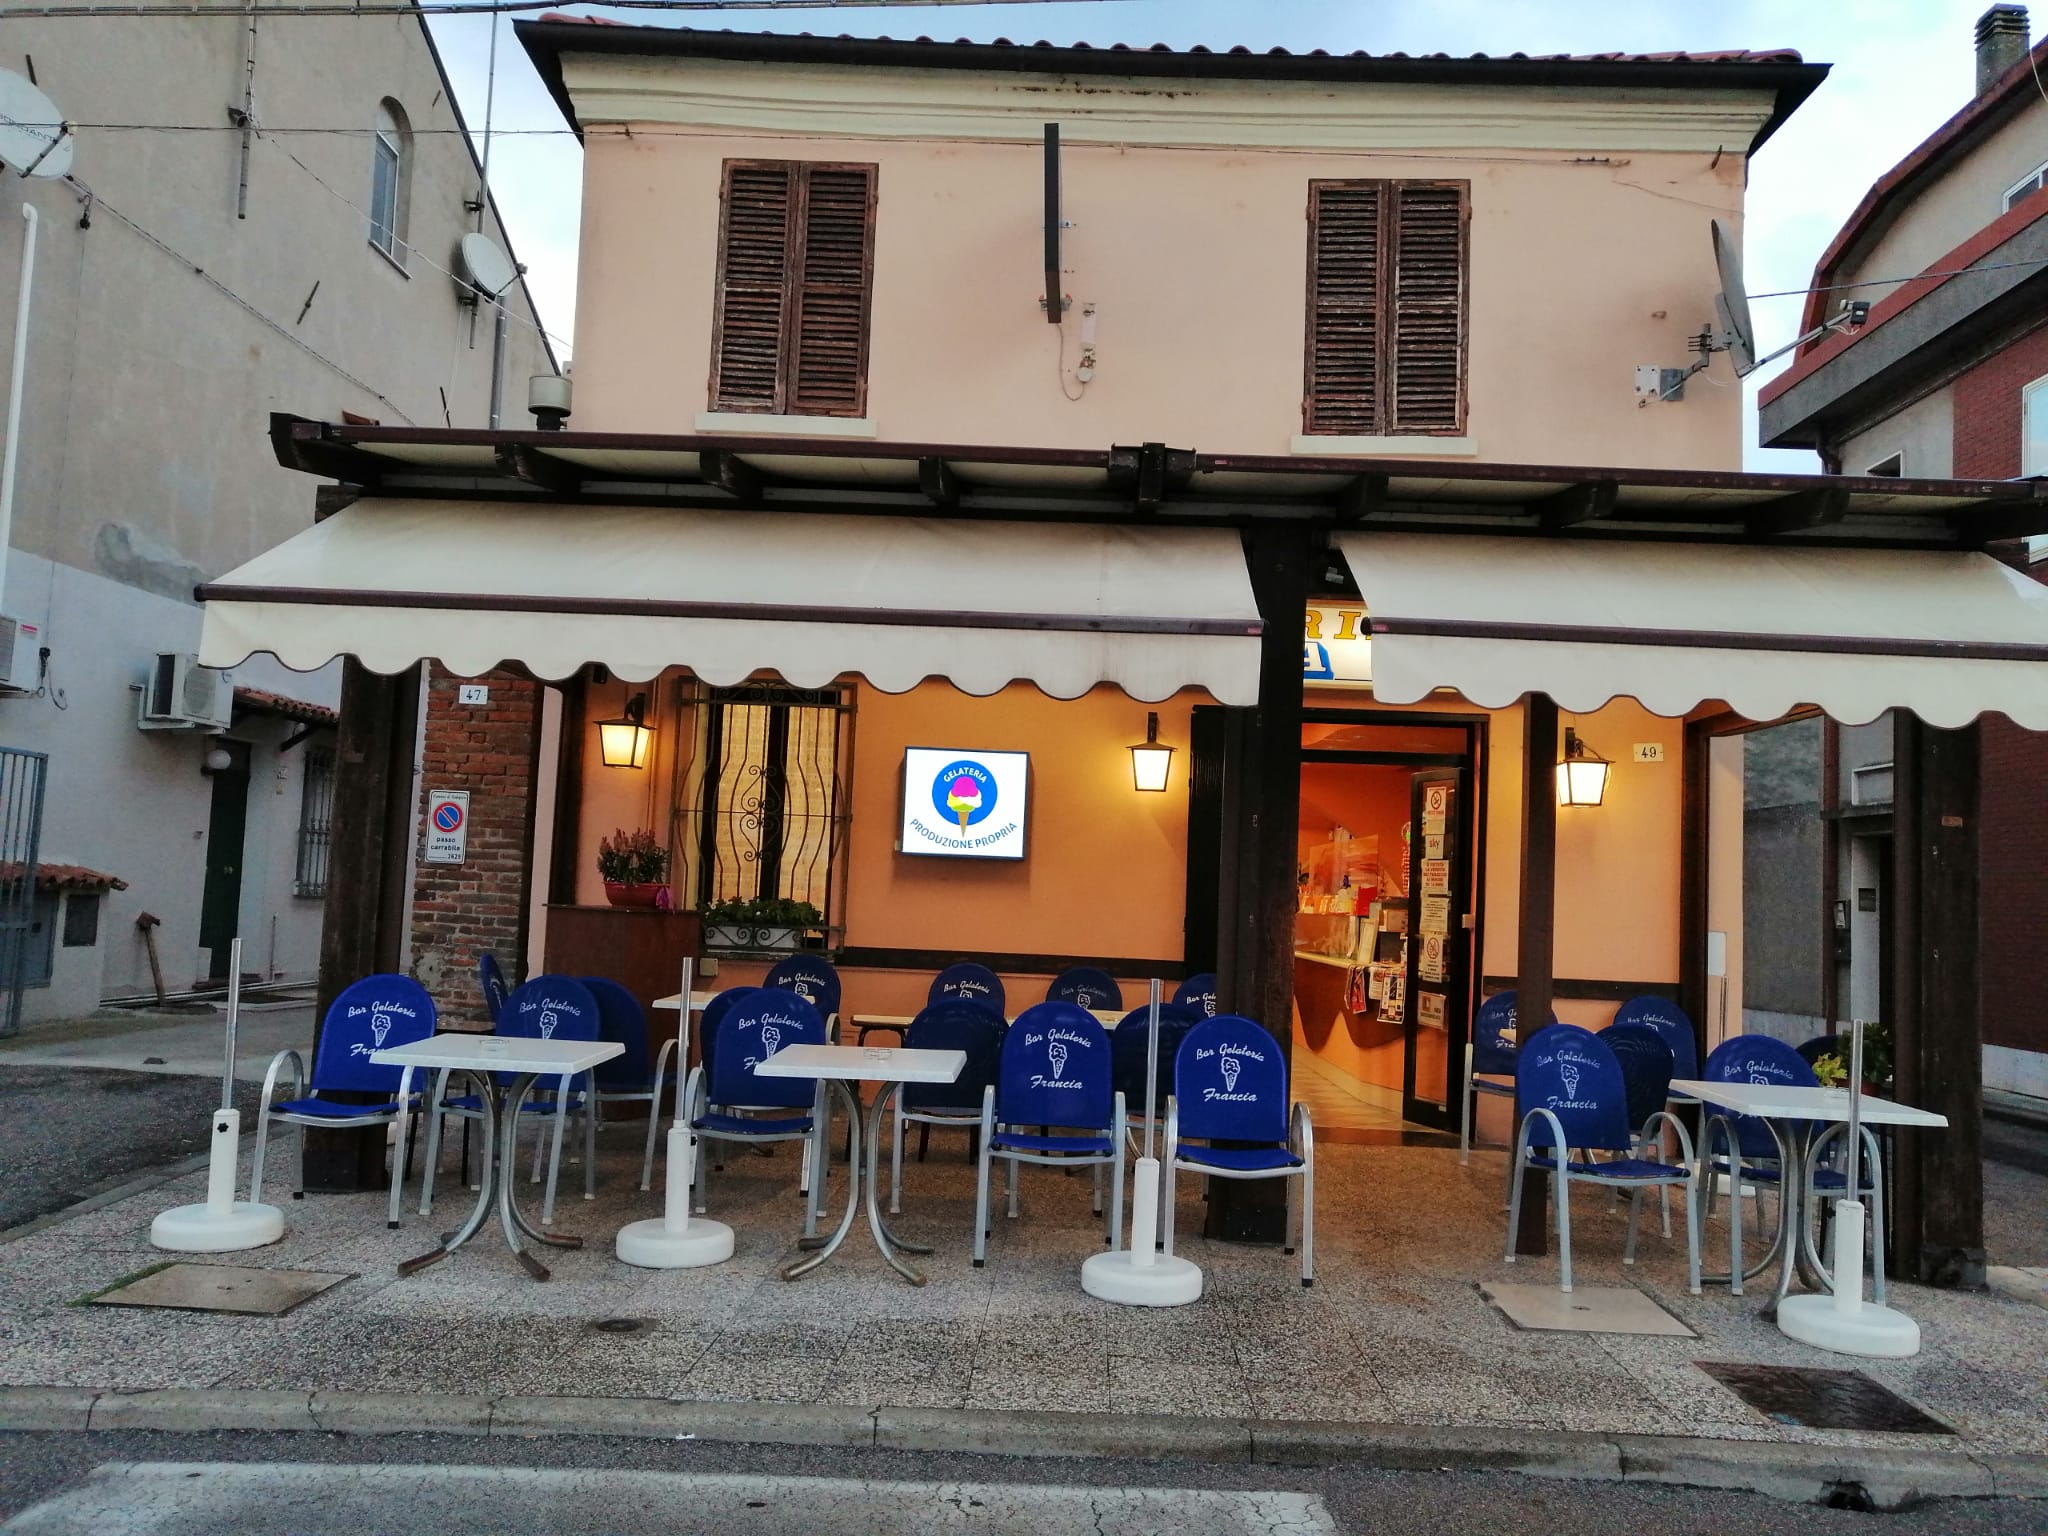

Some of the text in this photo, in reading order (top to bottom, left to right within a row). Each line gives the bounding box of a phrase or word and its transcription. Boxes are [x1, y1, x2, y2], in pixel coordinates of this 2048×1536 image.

[466, 689, 481, 701] 47
[1641, 746, 1657, 759] 49
[943, 767, 987, 783] GELATERIA
[910, 818, 1018, 849] PRODUZIONE PROPRIA
[779, 972, 825, 986] Bar Gelateria
[944, 980, 990, 994] Bar Gelateria
[520, 998, 581, 1016] Bar Gelateria
[1186, 996, 1200, 1005] Bar
[348, 1001, 416, 1018] Bar Gelateria
[738, 1013, 804, 1030] Bar Gelateria
[1025, 1028, 1092, 1048] Bar Gelateria
[1196, 1043, 1265, 1062] Bar Gelateria
[1557, 1049, 1601, 1069] Gelateria
[1724, 1060, 1794, 1080] Bar Gelateria
[1030, 1075, 1084, 1090] Francia
[1202, 1087, 1258, 1103] Francia
[1546, 1095, 1598, 1110] Francia
